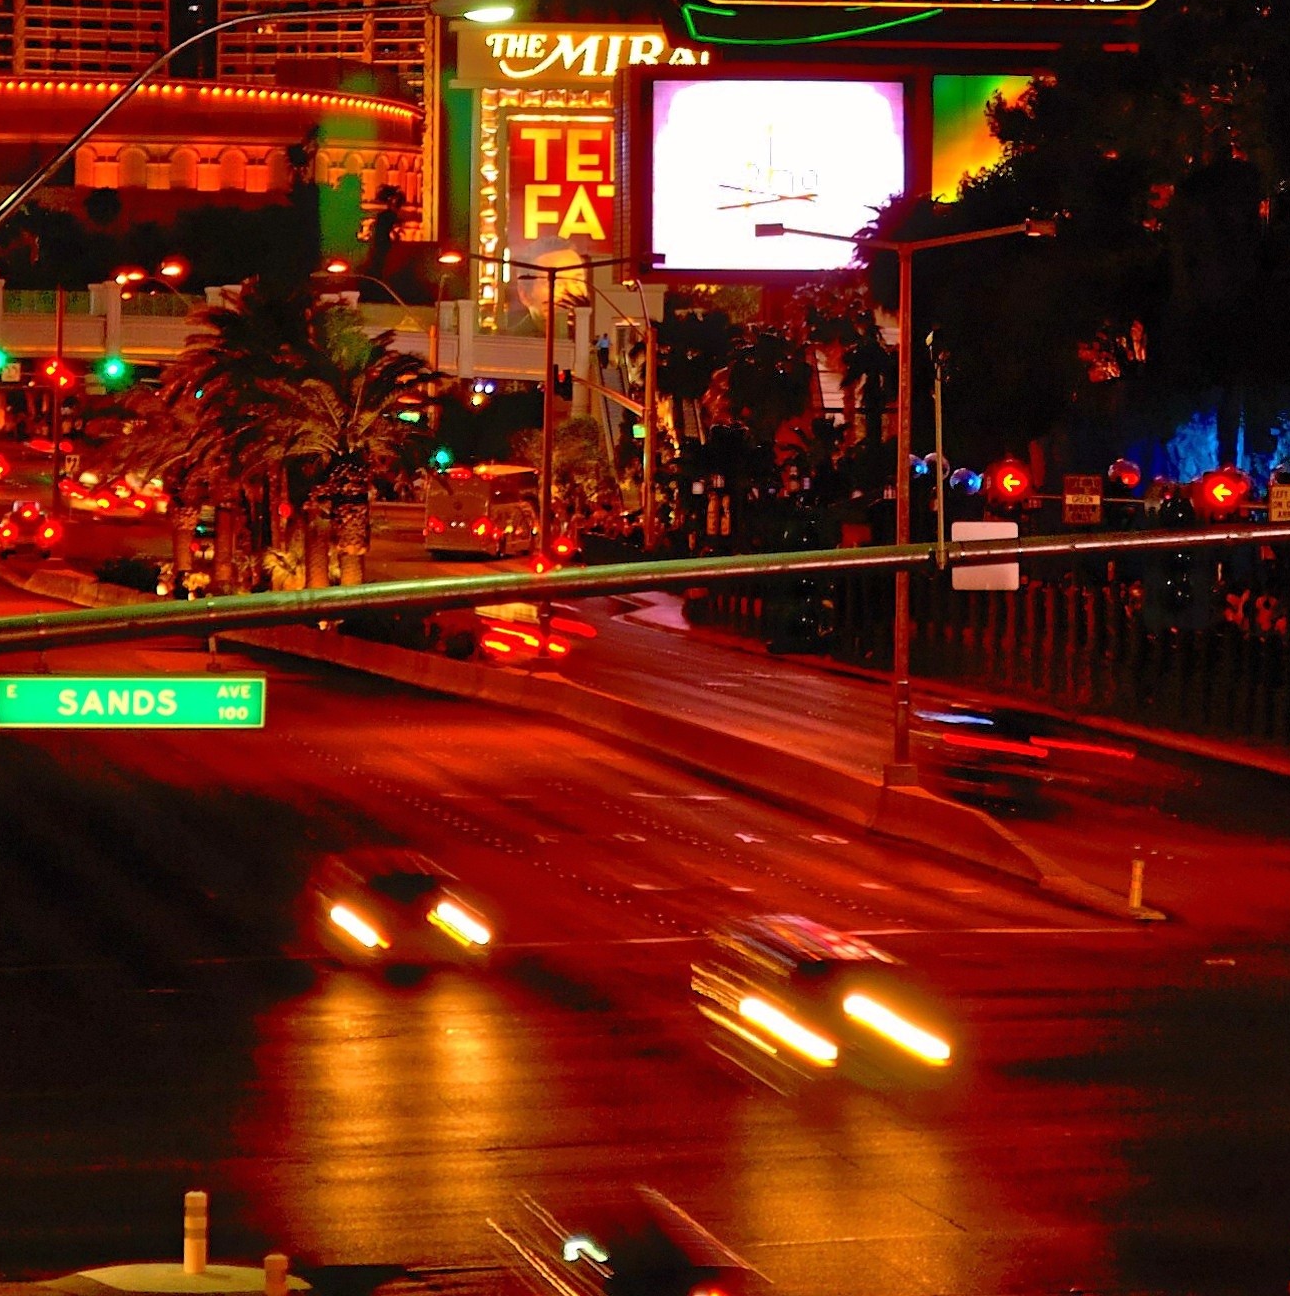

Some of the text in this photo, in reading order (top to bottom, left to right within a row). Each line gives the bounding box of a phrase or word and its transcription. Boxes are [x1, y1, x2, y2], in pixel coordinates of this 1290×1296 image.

[485, 33, 548, 59] THE
[520, 128, 615, 182] TE
[5, 683, 252, 717] E SANDS AVE
[217, 706, 249, 721] 100
